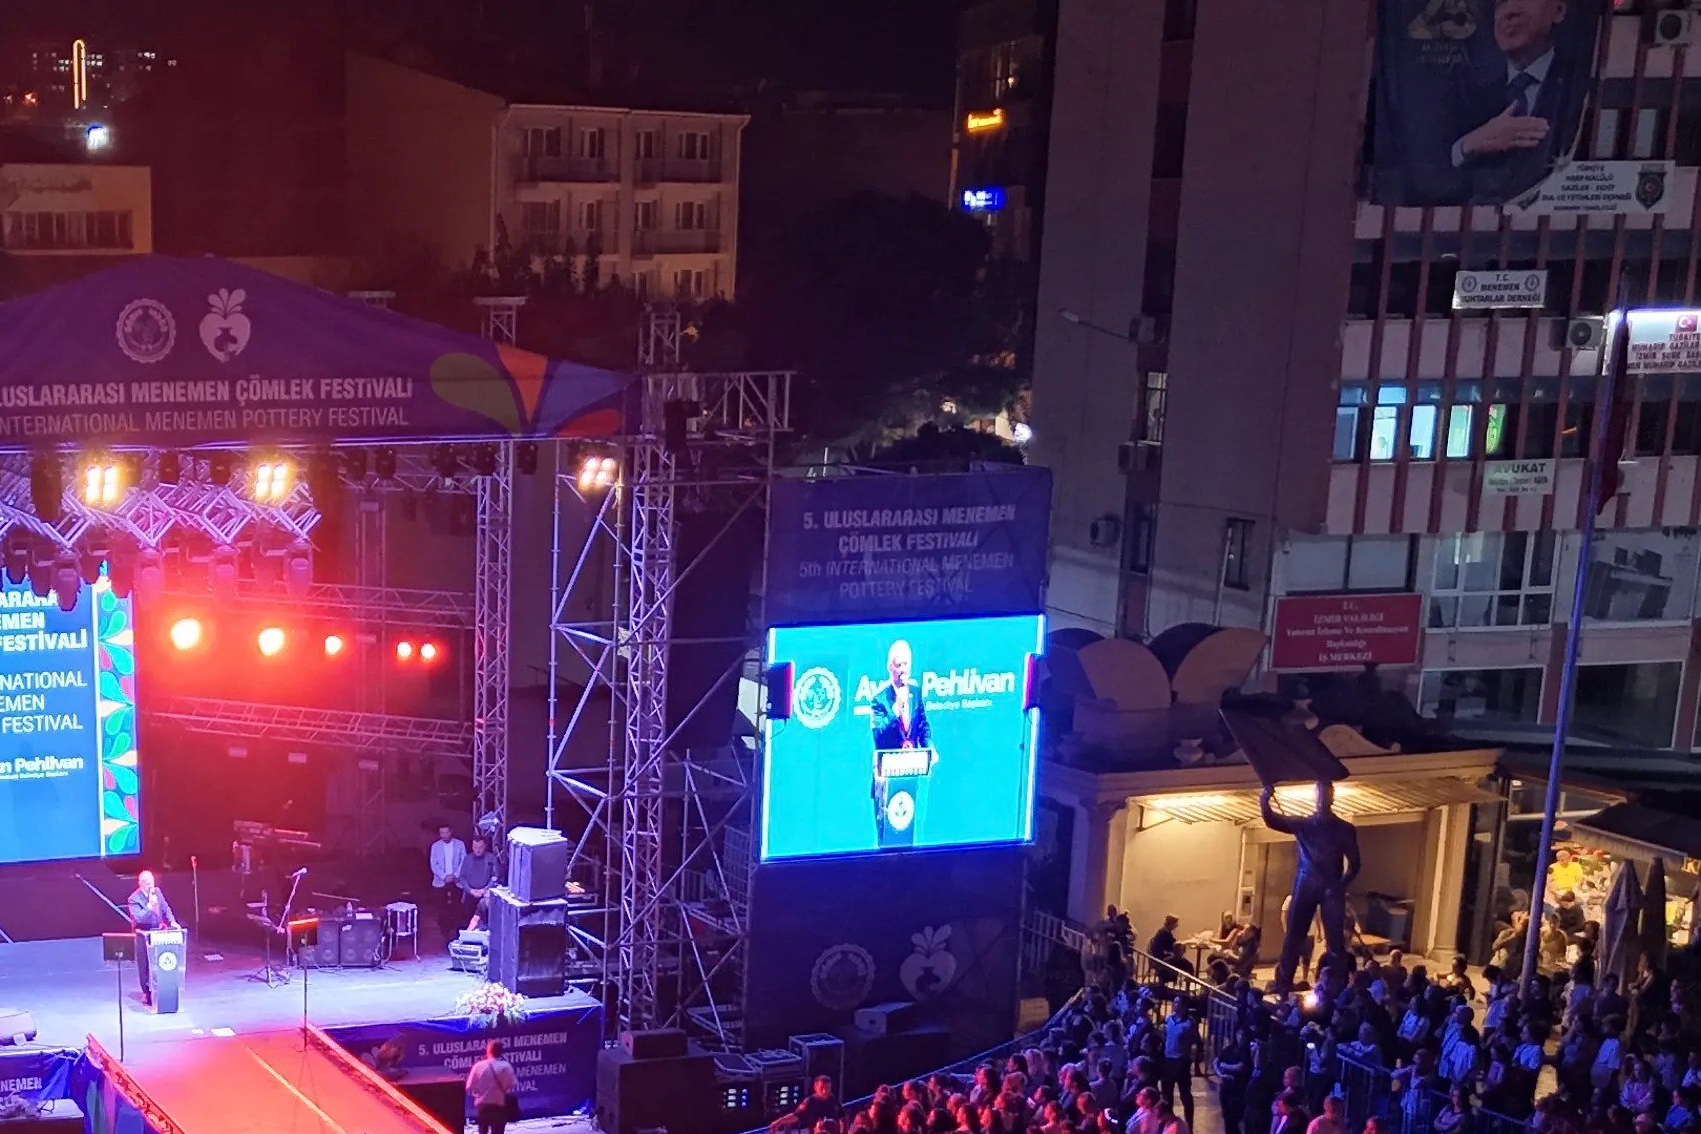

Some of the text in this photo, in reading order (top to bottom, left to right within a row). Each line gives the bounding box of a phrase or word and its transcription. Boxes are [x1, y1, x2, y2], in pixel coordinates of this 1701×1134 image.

[1480, 283, 1520, 292] MENEMEN
[131, 379, 229, 404] MENEMEN
[235, 374, 315, 406] ÇÖMLEK
[145, 409, 237, 431] MENEMEN
[242, 408, 323, 429] POTTERY
[329, 406, 410, 427] FESTIVAL
[1494, 462, 1547, 474] AVUKAT
[803, 504, 1017, 530] 5. ULUSLARARASI MENEMEN
[838, 530, 902, 557] ÇÖMLEK
[799, 552, 1014, 578] 5th INTERNATIONAL MENEMEN
[839, 577, 973, 599] POTTERY FESTIVAL
[921, 667, 1015, 698] Pehlivan
[2, 713, 84, 734] FESTIVAL
[14, 755, 84, 773] Pehlivan
[418, 1044, 430, 1056] 5.
[513, 1032, 568, 1048] MENEMEN
